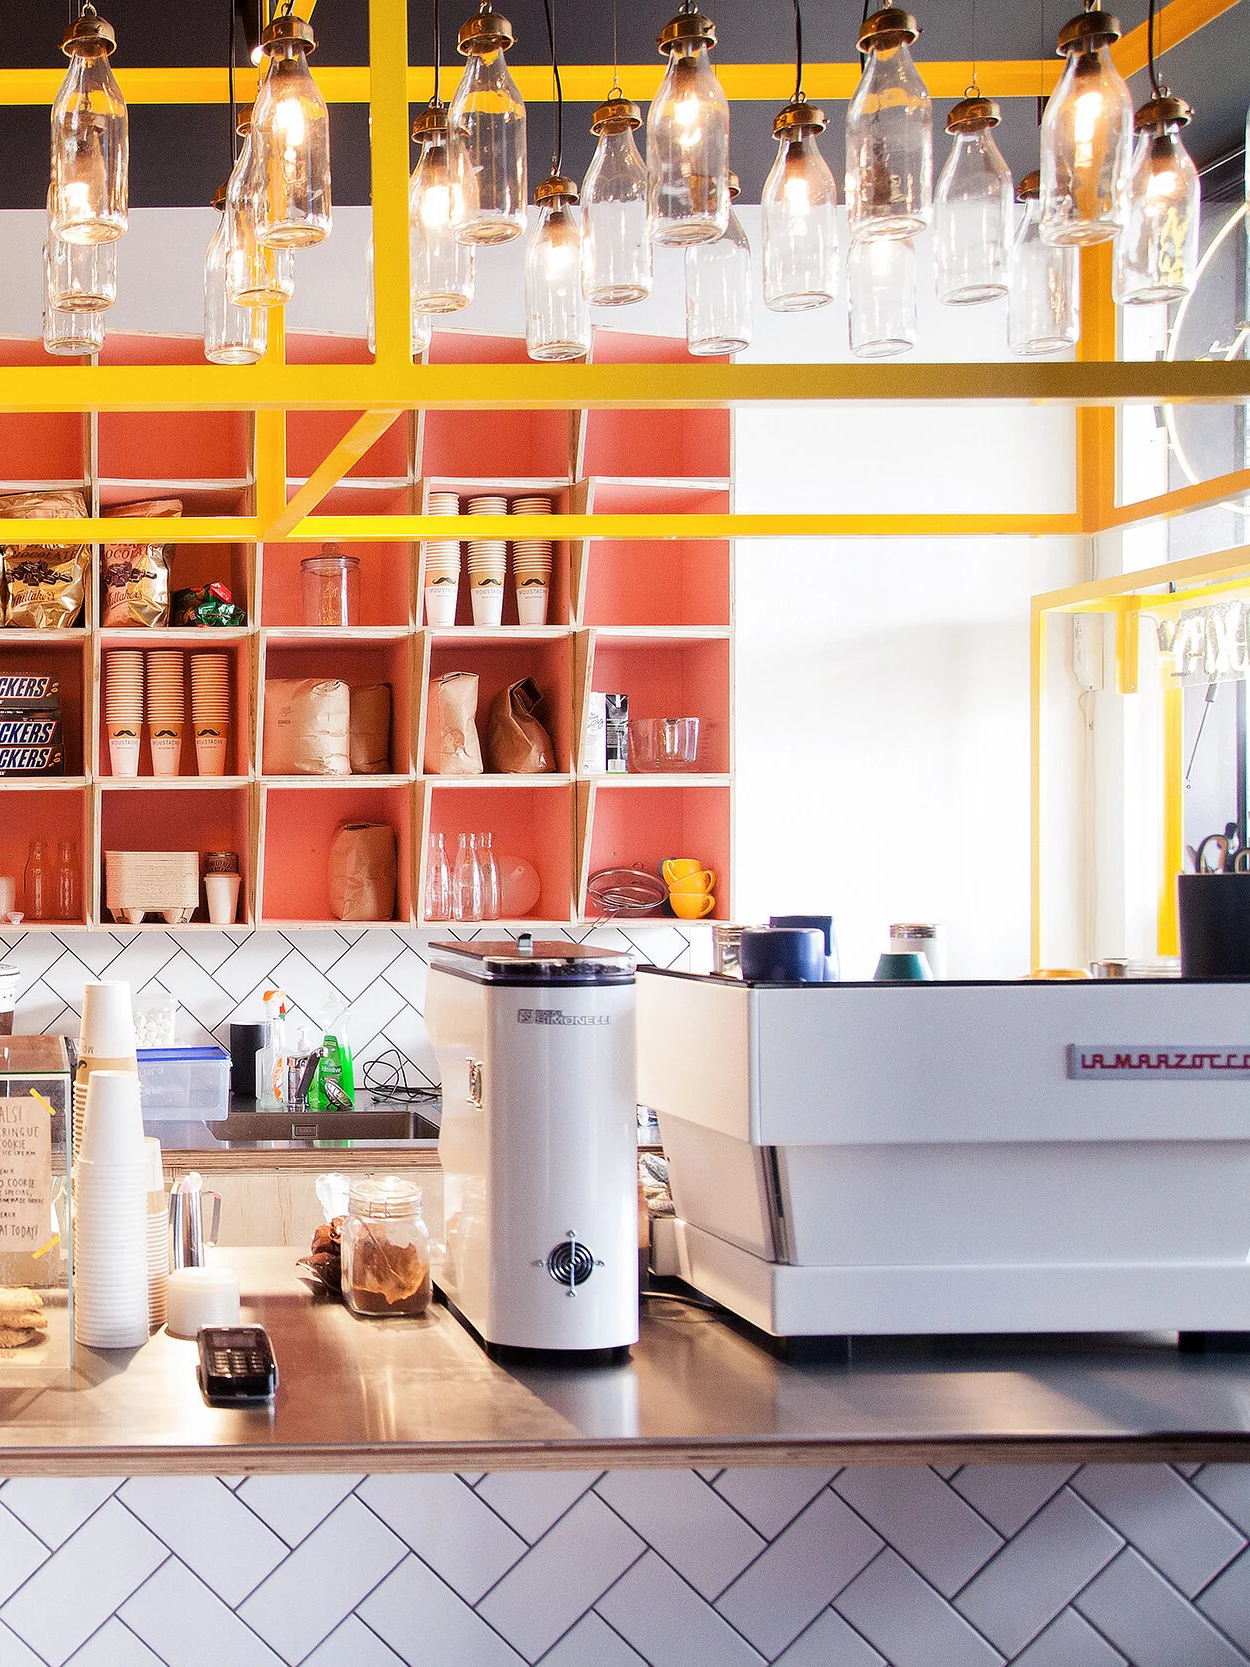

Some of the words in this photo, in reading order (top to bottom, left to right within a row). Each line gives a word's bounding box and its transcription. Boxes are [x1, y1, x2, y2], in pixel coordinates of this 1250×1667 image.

[535, 1016, 611, 1025] SIMONELLI
[7, 1178, 35, 1189] COOKIE
[11, 1224, 39, 1239] TODAY!
